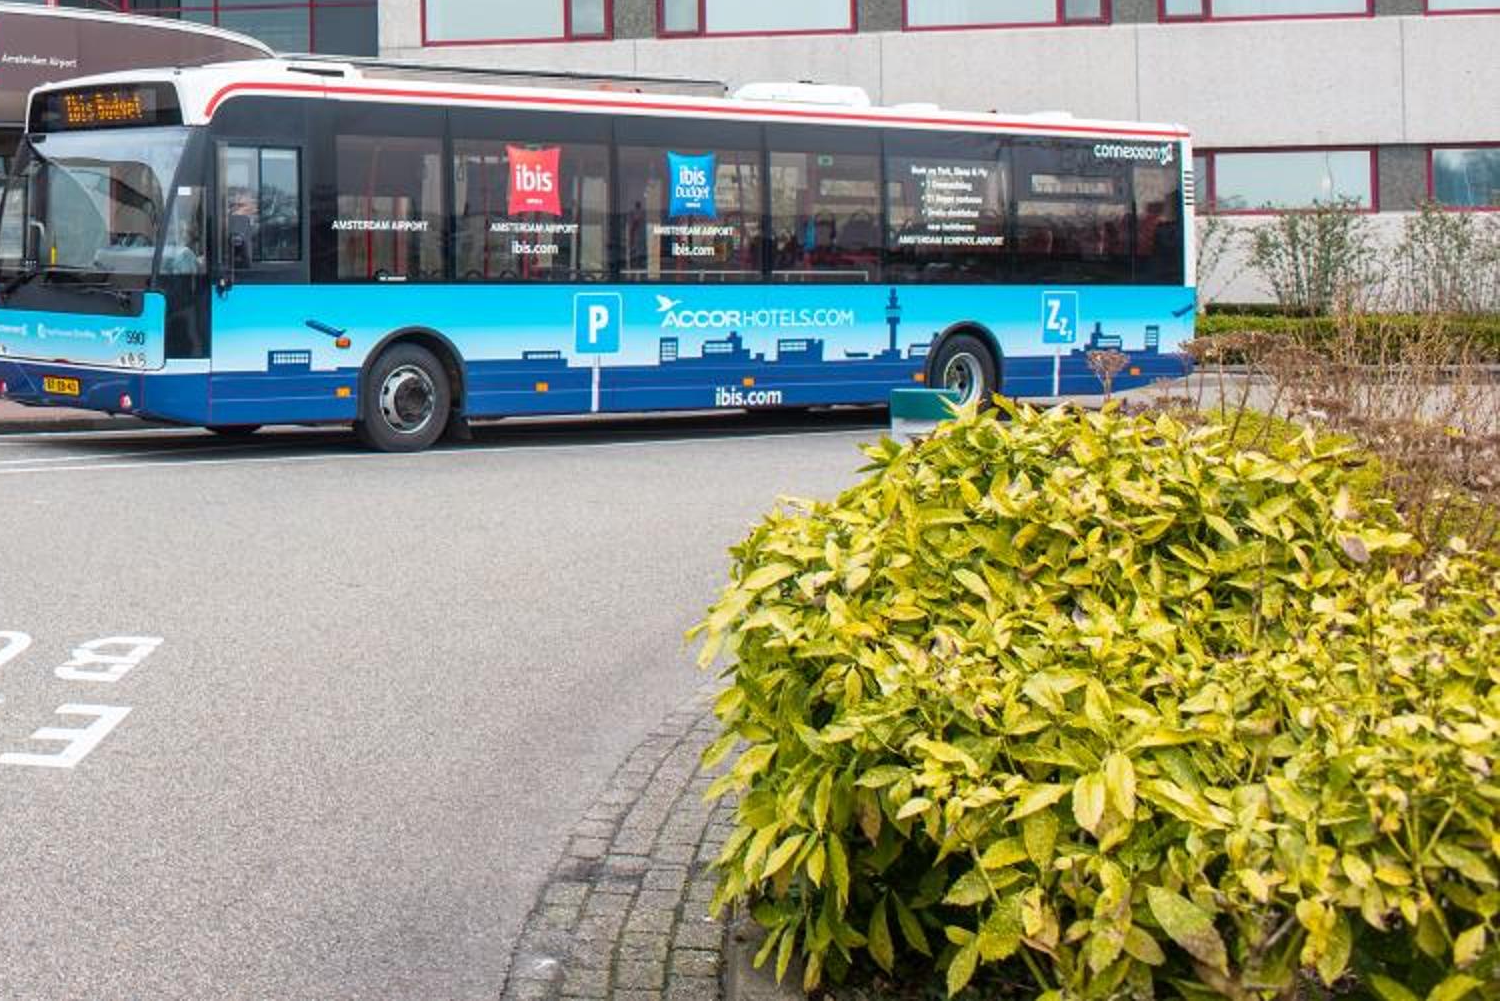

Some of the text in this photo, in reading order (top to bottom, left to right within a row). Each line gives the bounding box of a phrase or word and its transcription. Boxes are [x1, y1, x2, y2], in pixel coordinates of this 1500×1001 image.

[1, 54, 77, 69] Amsterdam Airport
[515, 163, 553, 192] ibis
[680, 165, 707, 186] ibis
[675, 184, 710, 202] budget
[331, 220, 429, 232] AMSTERDAM AIRPORT
[490, 222, 579, 234] AMSTERDAM AIRPORT
[653, 225, 734, 236] AMSTERDAM AIRPORT
[511, 241, 559, 254] ibis.com
[671, 243, 715, 256] ibis.com
[589, 305, 609, 344] P
[661, 309, 854, 328] ACCORHOTELS.COM
[715, 386, 782, 406] ibis.com
